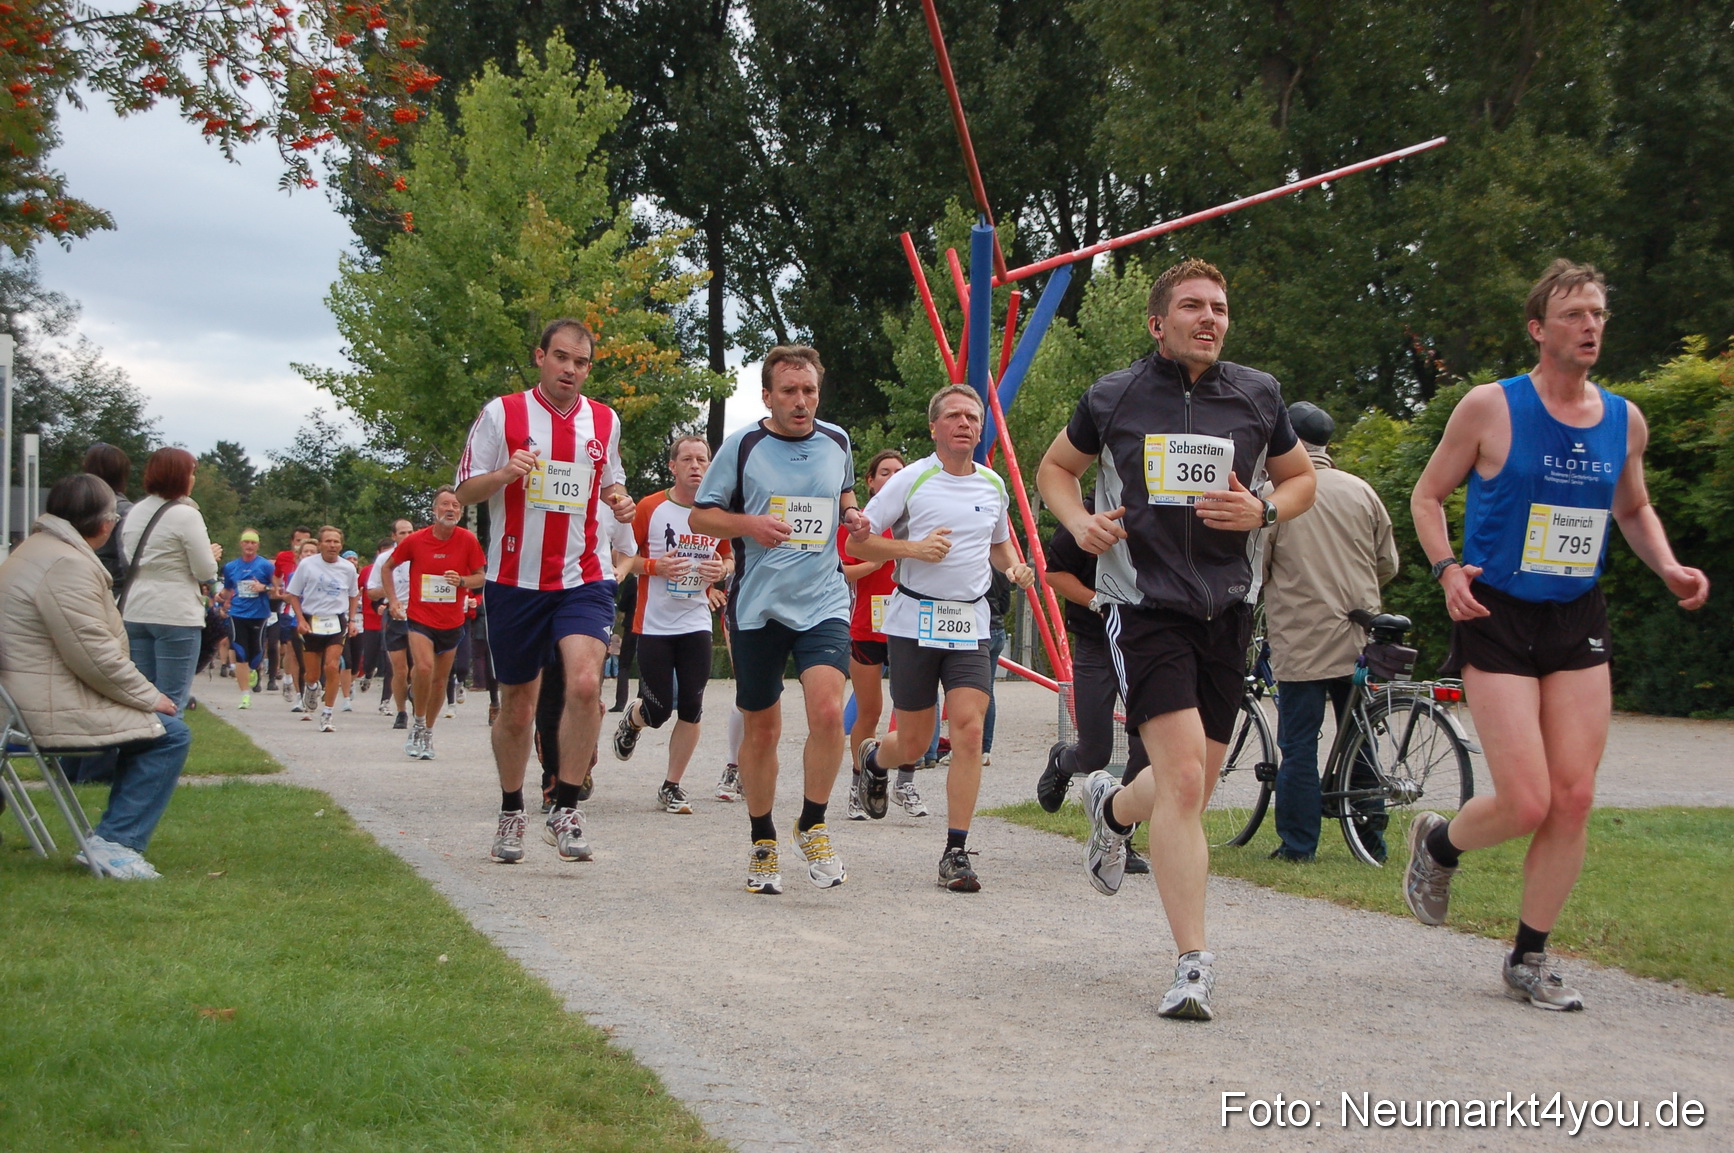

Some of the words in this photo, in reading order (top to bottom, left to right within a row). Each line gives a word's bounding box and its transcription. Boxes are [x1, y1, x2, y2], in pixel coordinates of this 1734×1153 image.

[1169, 440, 1224, 456] Sebastian
[547, 464, 571, 477] Bernd
[1148, 460, 1153, 471] B
[1543, 455, 1612, 473] ELOTEC
[1176, 462, 1216, 483] 366
[531, 477, 537, 485] C
[553, 481, 579, 497] 103
[788, 501, 812, 513] Jakob
[793, 518, 823, 534] 372
[1552, 512, 1593, 528] Heinrich
[679, 533, 716, 547] MERZ
[1529, 530, 1536, 540] C
[1558, 534, 1592, 555] 795
[434, 585, 451, 593] 356
[937, 605, 962, 616] Helmut
[937, 619, 971, 633] 2803
